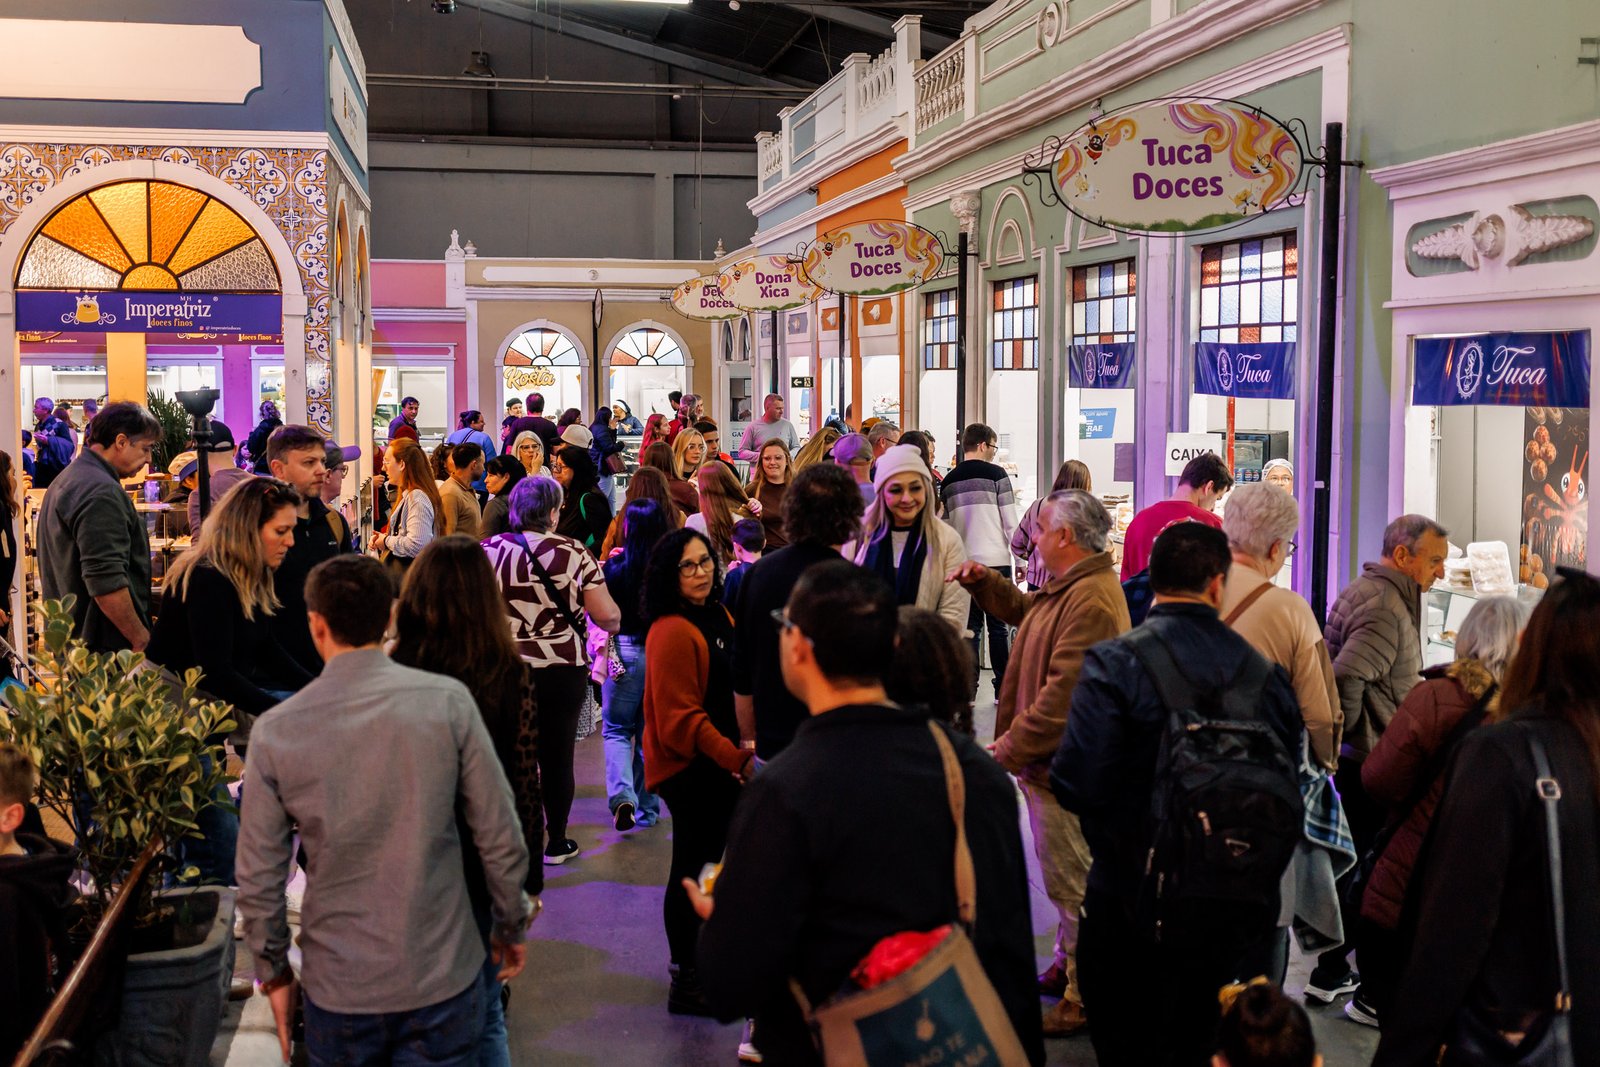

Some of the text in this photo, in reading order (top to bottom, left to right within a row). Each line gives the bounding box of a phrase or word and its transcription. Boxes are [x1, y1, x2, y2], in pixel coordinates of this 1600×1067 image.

[1141, 138, 1212, 167] Tuca
[1132, 172, 1224, 200] Doces
[854, 242, 895, 258] Tuca
[755, 272, 792, 285] Dona
[850, 261, 902, 278] Doces
[760, 285, 790, 298] Xica
[124, 297, 212, 328] Imperatriz
[151, 317, 193, 327] doces finos
[1097, 351, 1120, 377] Tuca
[1235, 352, 1272, 383] Tuca
[1485, 345, 1548, 385] Tuca
[503, 366, 556, 391] Kosta
